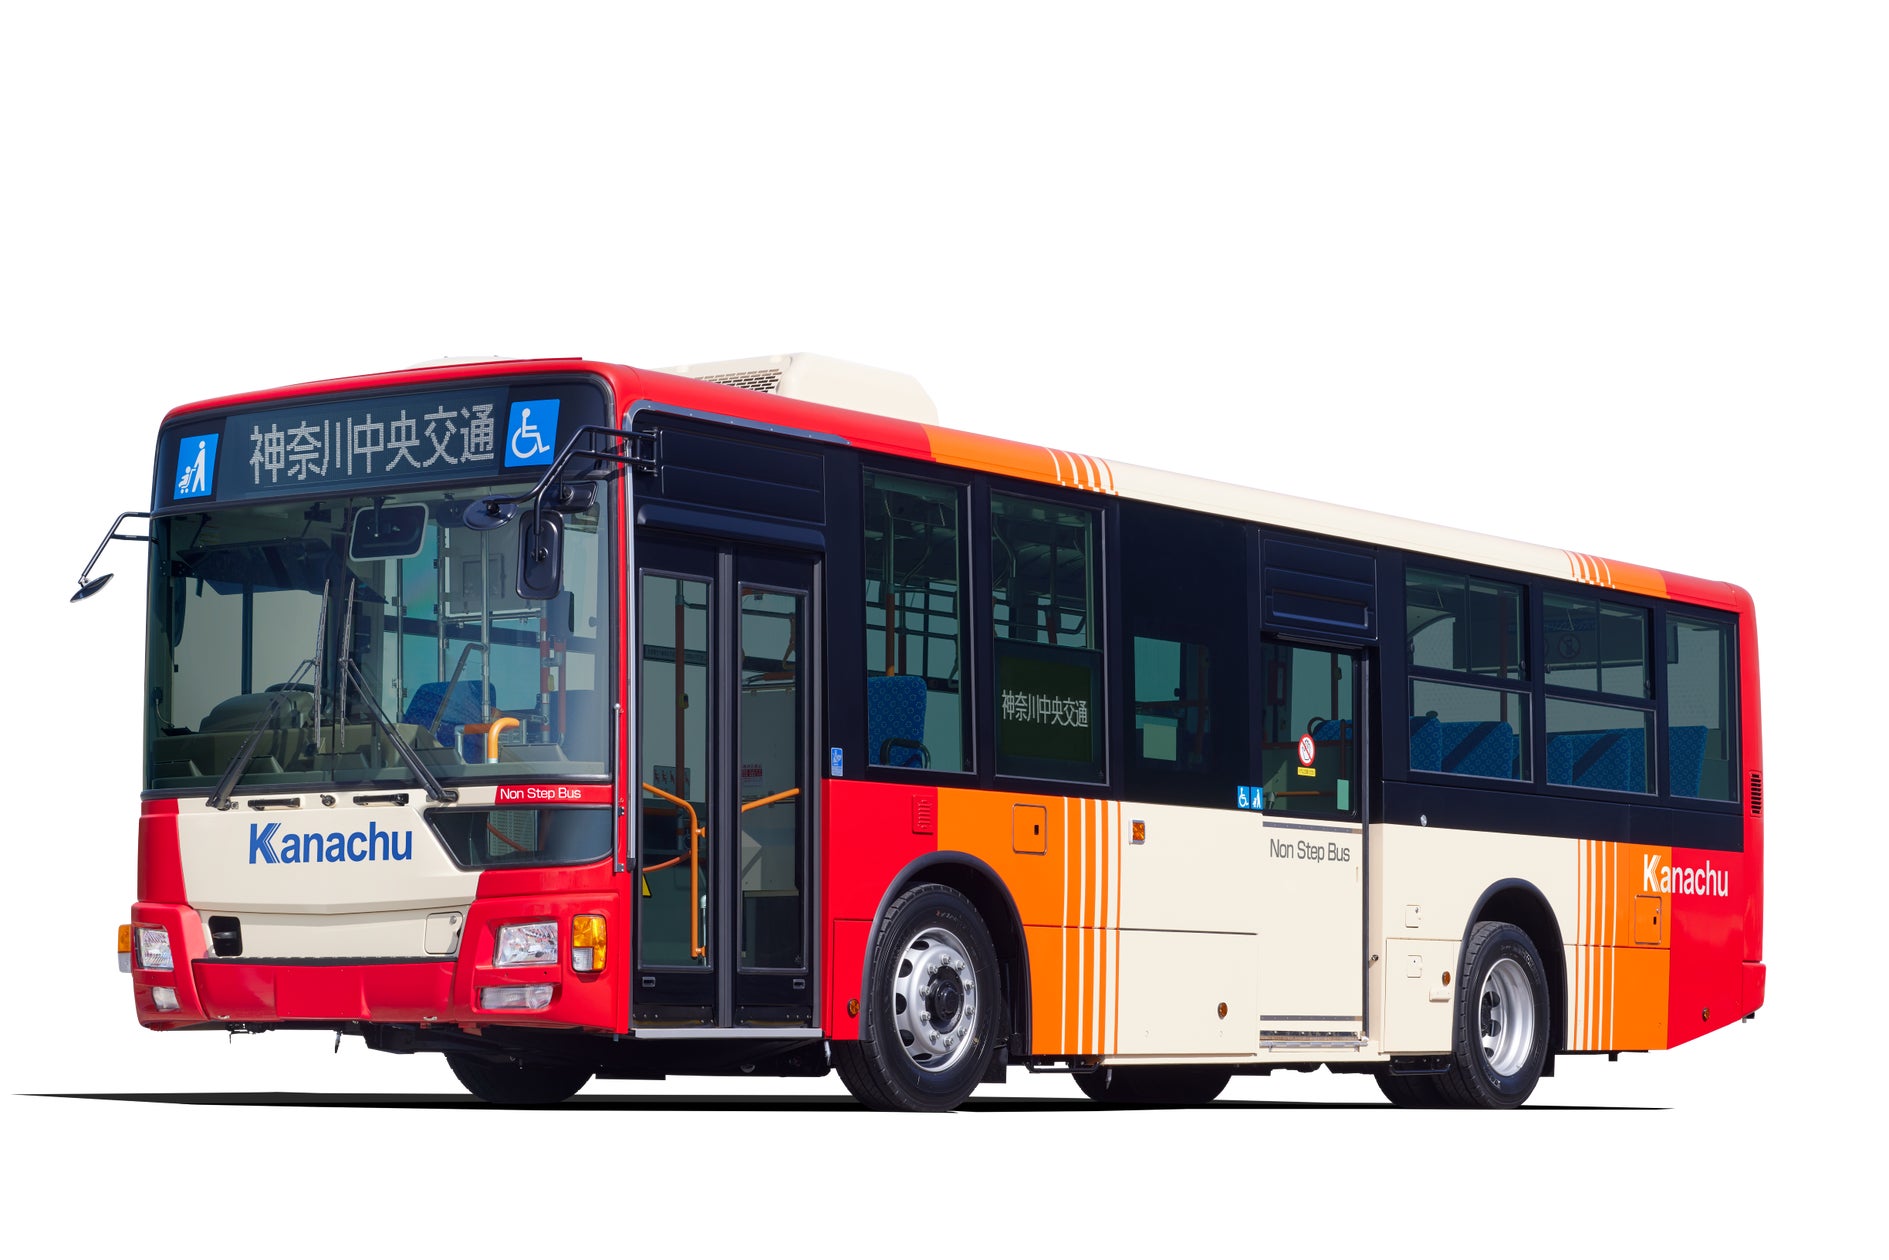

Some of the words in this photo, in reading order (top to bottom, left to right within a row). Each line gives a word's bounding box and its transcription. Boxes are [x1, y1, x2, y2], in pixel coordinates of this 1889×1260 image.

[249, 403, 495, 484] 神奈川中央交通
[1001, 689, 1089, 728] 神奈川中央交通
[500, 788, 524, 799] Non
[527, 787, 556, 799] Step
[558, 787, 581, 798] Bus
[249, 821, 413, 864] Kanachu
[1270, 838, 1294, 859] Non
[1297, 840, 1325, 863] Step
[1327, 842, 1351, 862] Bus
[1643, 853, 1729, 897] Kanachu
